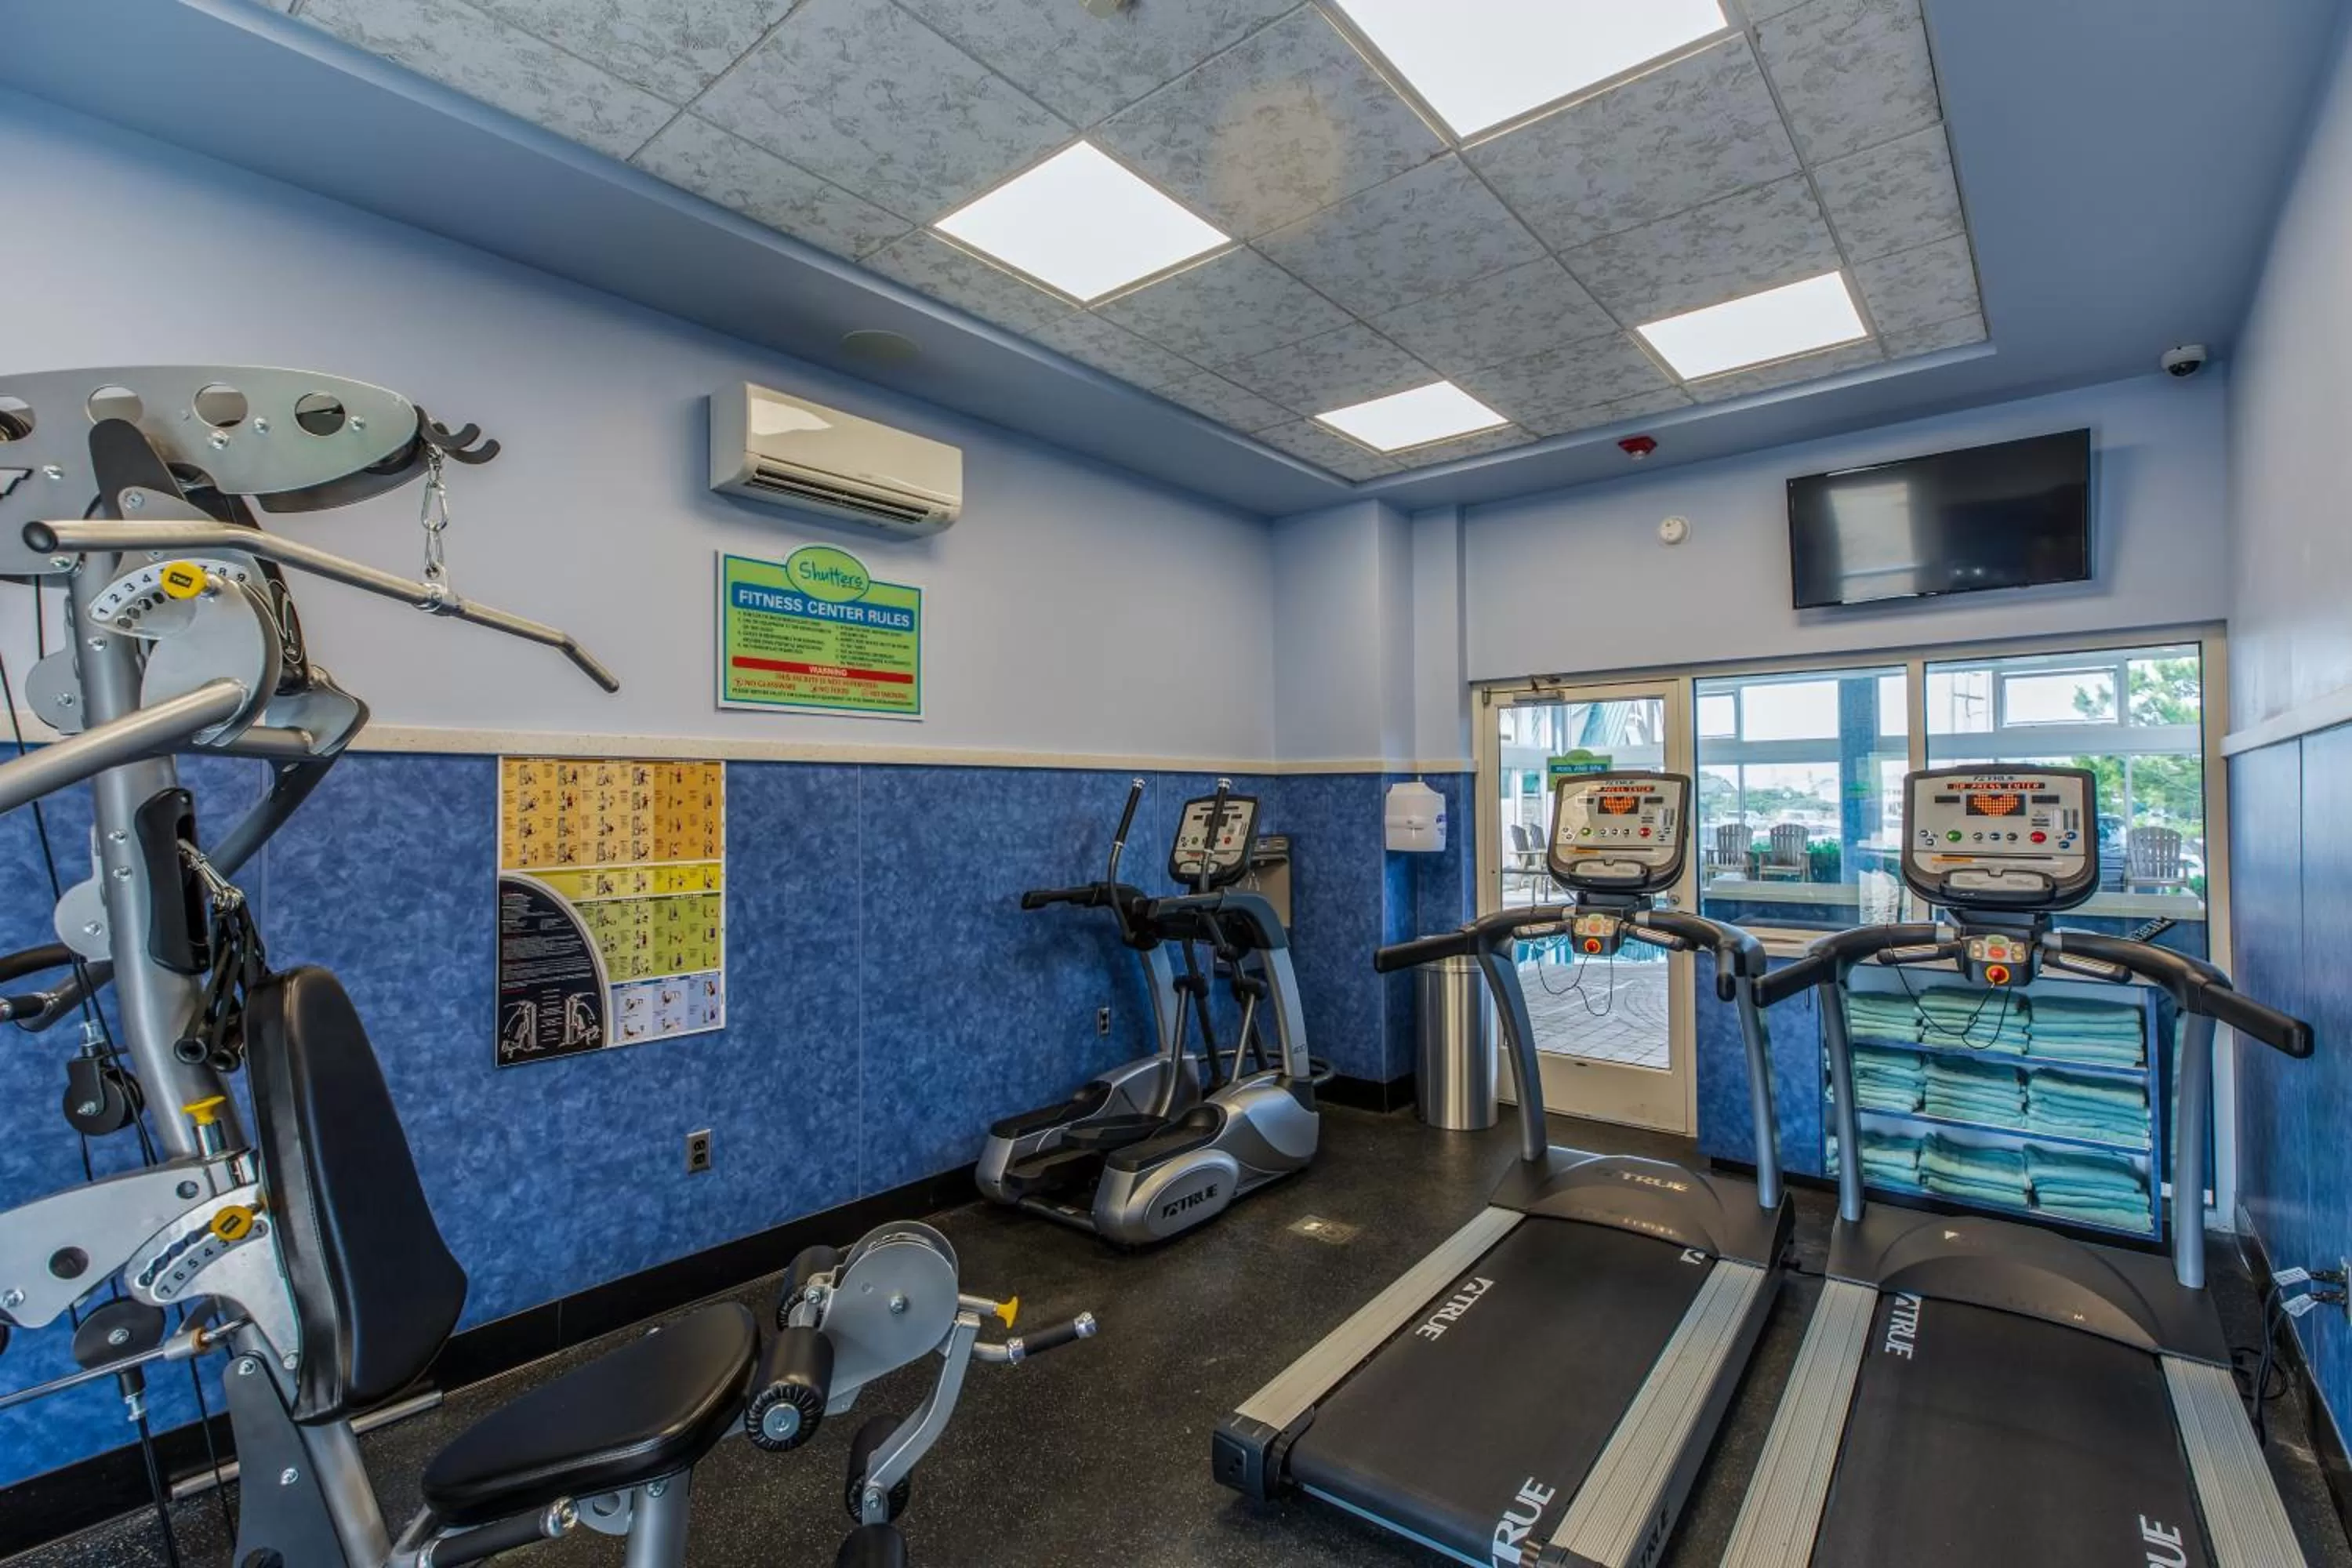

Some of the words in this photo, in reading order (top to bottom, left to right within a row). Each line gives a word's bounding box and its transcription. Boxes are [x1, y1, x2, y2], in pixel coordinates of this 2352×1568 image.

[110, 593, 122, 603] 2
[124, 583, 136, 592] 3
[142, 574, 152, 583] 4
[237, 573, 246, 583] 9
[799, 561, 862, 589] Shutters
[739, 589, 803, 612] FITNESS
[807, 601, 864, 621] CENTER
[868, 609, 910, 627] RULES
[808, 666, 848, 677] WARNING
[1179, 1182, 1218, 1212] TRUE
[161, 1285, 172, 1294] 7
[174, 1271, 185, 1280] 6
[188, 1258, 198, 1268] 5
[205, 1247, 214, 1256] 4
[1415, 1294, 1480, 1341] TRUE
[1885, 1309, 1918, 1360] TRUE
[1492, 1476, 1555, 1568] RUE
[2139, 1514, 2187, 1568] UE
